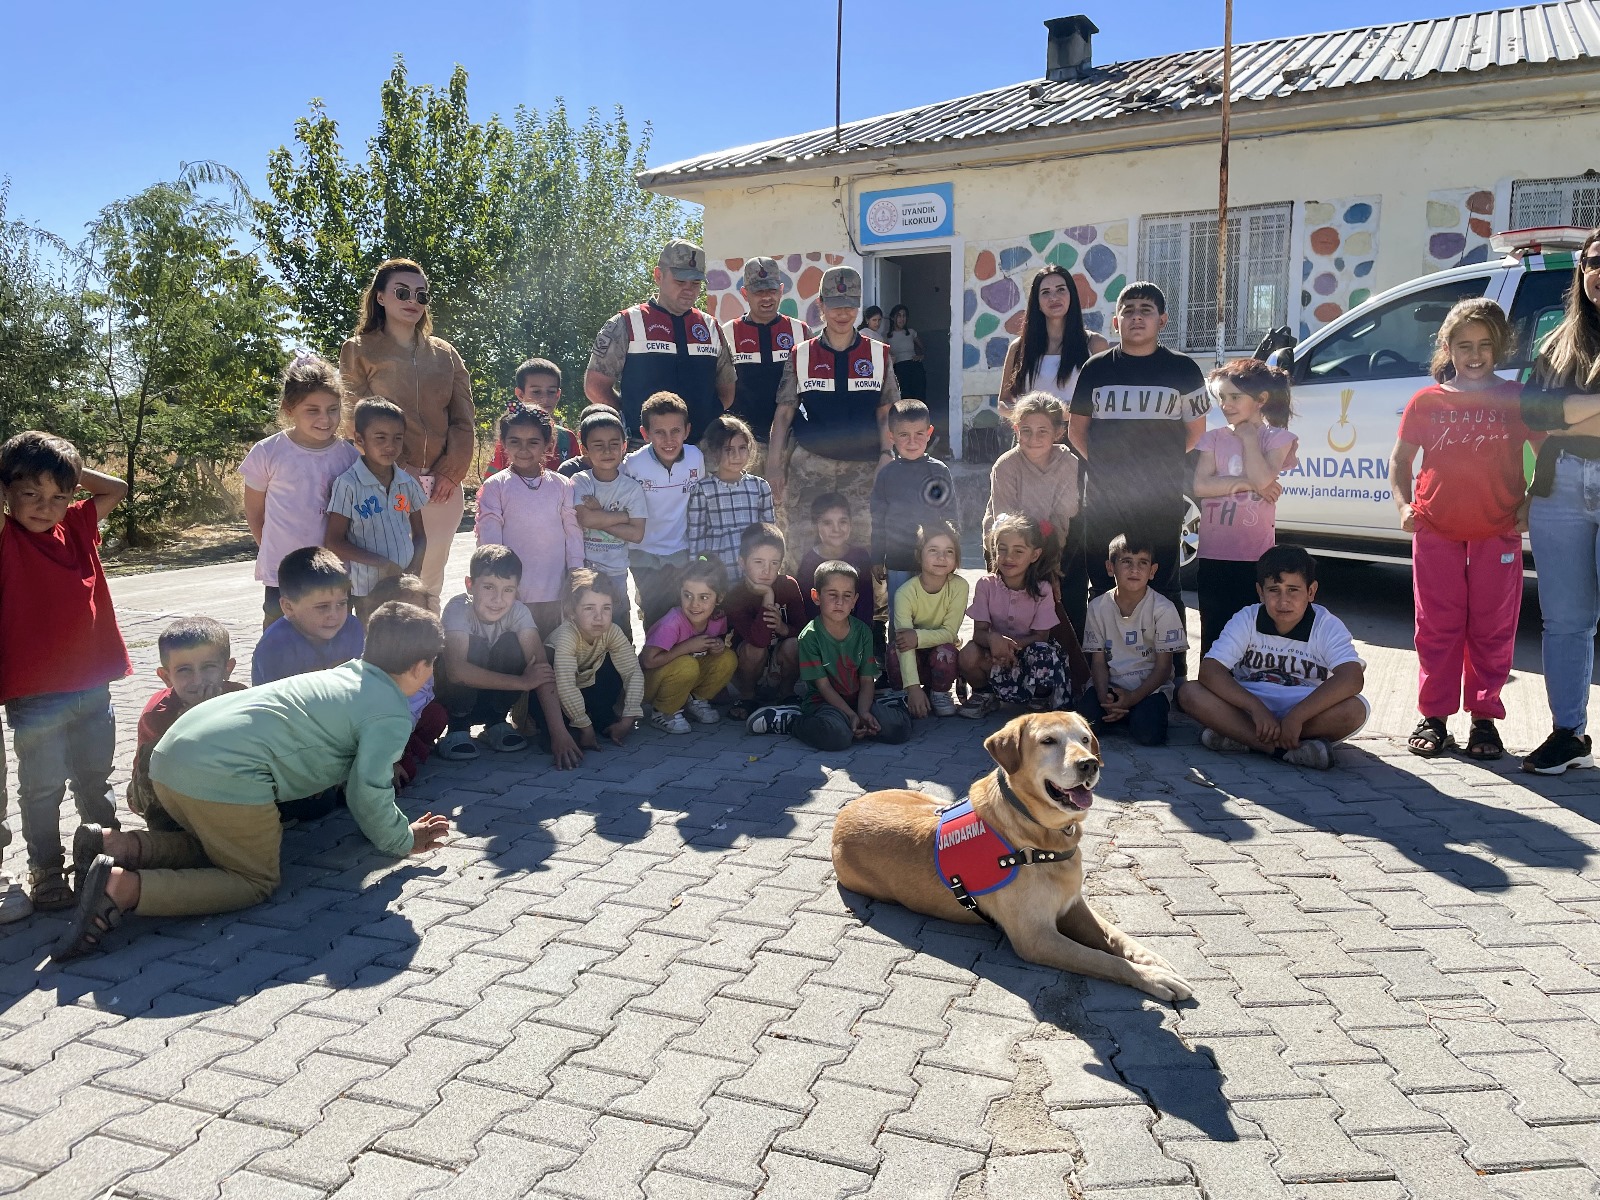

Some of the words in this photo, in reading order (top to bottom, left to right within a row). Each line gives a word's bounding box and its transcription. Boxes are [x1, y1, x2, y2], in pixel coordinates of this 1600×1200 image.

[902, 206, 935, 216] UYANDIK
[902, 216, 938, 226] İLKOKULU
[646, 342, 670, 351] ÇEVRE
[803, 380, 826, 389] ÇEVRE
[854, 380, 880, 389] KORUMA
[1430, 409, 1507, 424] BECAUSE
[1240, 650, 1329, 681] ROOKLYN
[938, 820, 986, 850] JANDARMA
